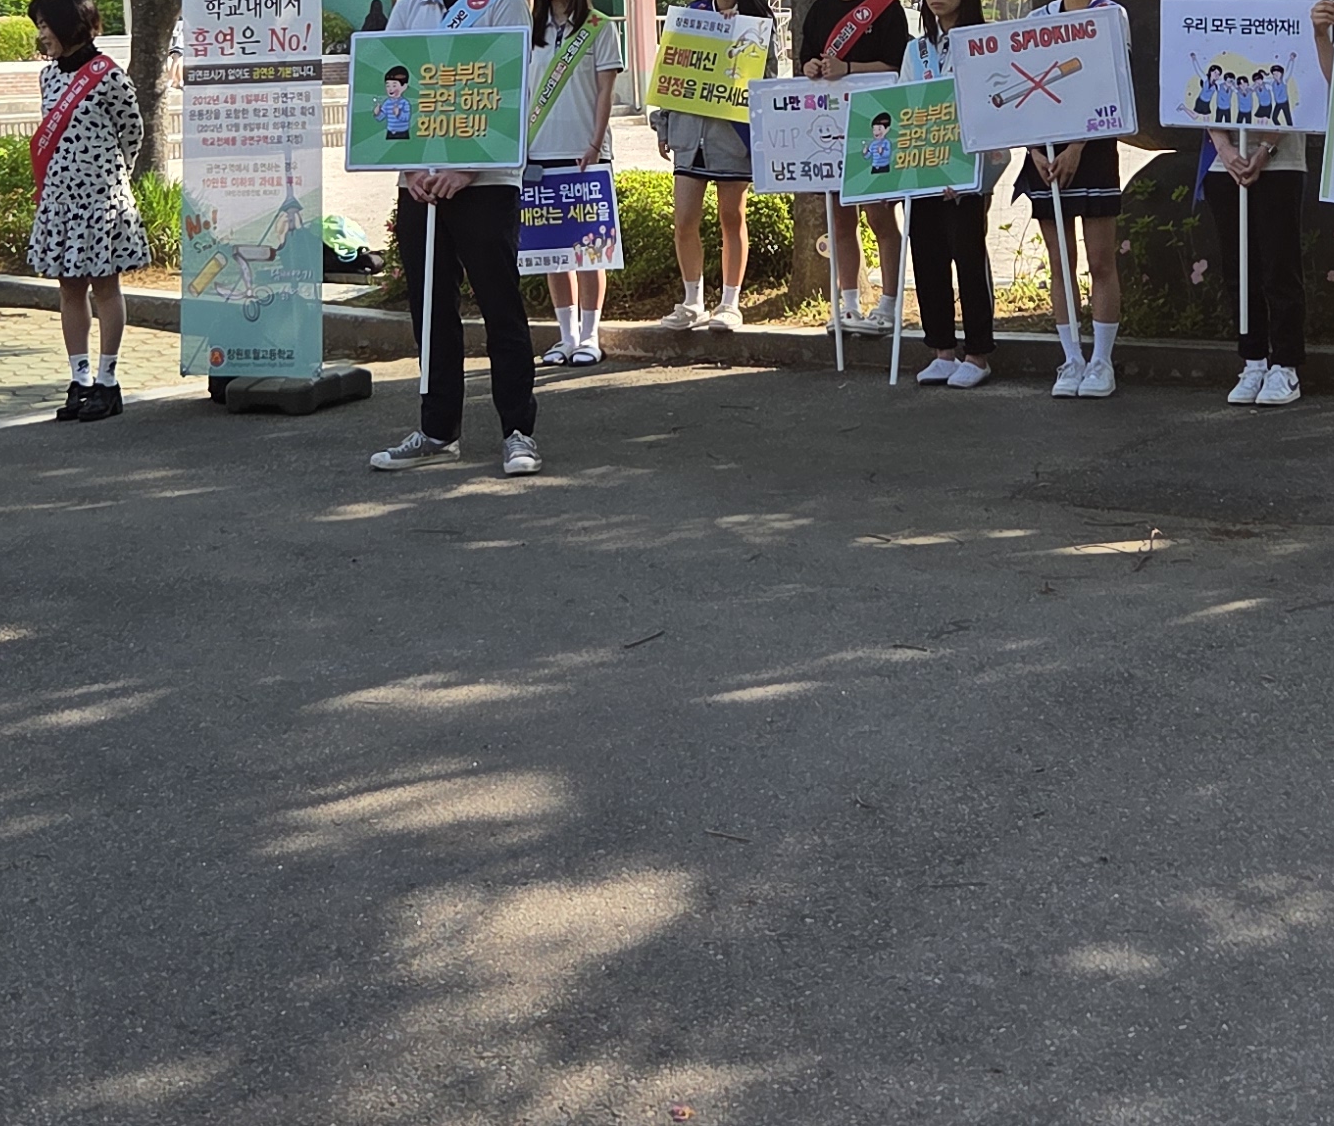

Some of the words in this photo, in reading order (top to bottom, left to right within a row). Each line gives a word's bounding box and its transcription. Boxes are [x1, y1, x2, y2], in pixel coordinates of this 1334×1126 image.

[675, 17, 732, 34] 창원토월고등학교
[1182, 17, 1208, 35] 우리
[1210, 18, 1238, 35] 모두
[1239, 18, 1300, 36] 금연하자!!
[189, 25, 261, 58] 흡연은
[268, 23, 311, 53] No!
[968, 35, 999, 56] NO
[1010, 20, 1097, 53] SMOKING
[662, 45, 718, 72] 담배대신
[187, 69, 226, 82] 금연표시가
[228, 68, 250, 80] 없어도
[252, 66, 275, 79] 금연은
[277, 65, 316, 79] 기본입니다.
[419, 61, 495, 86] 오늘부터
[192, 94, 220, 106] 2012년
[223, 93, 237, 105] 4월
[241, 92, 269, 104] 1일부터
[272, 90, 311, 103] 금연구역을
[418, 89, 455, 113] 금연
[460, 87, 503, 112] 하자
[699, 82, 750, 108] 태우세요
[773, 95, 801, 111] 나만
[225, 107, 249, 119] 포함한
[253, 106, 269, 118] 학교
[273, 106, 297, 118] 전체로
[898, 102, 956, 126] 오늘부터
[1094, 105, 1118, 118] VIP
[416, 114, 488, 139] 화이팅!!
[768, 127, 800, 149] VIP
[897, 127, 927, 149] 금연
[930, 123, 961, 144] 하자
[894, 146, 951, 170] 화이팅!!
[520, 185, 556, 205] 리는
[559, 181, 603, 203] 원해요
[567, 201, 610, 223] 세상을
[227, 347, 295, 361] 창원토월고등학교
